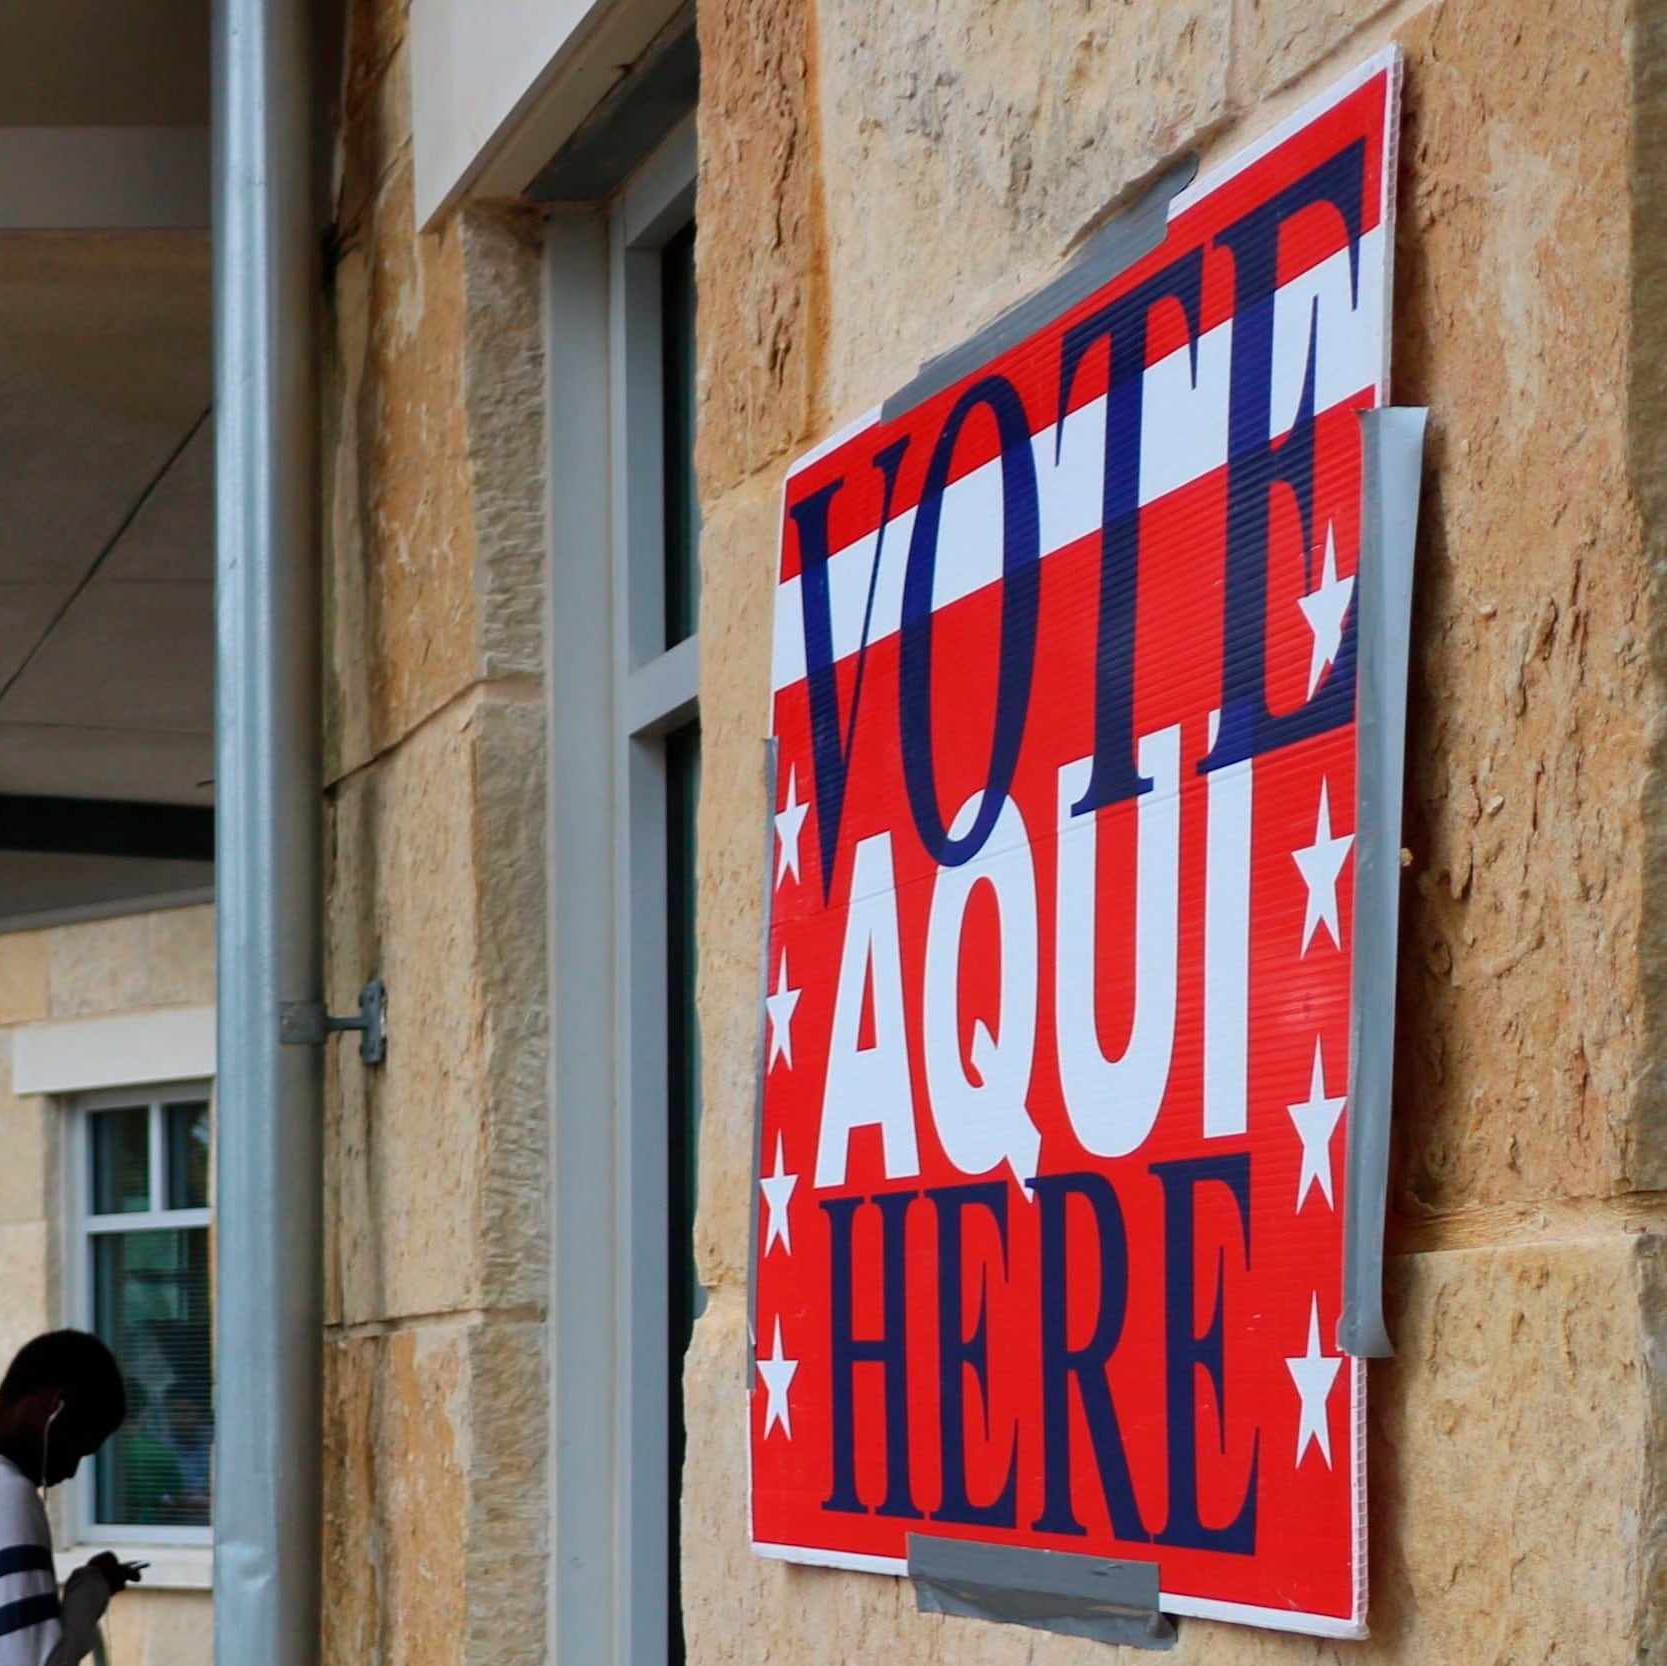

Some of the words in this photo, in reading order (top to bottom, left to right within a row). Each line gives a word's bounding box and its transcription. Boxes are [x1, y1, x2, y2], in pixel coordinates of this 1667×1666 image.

[788, 136, 1366, 908] VOTE
[813, 708, 1253, 1200] AQUI
[820, 1152, 1261, 1557] HERE
